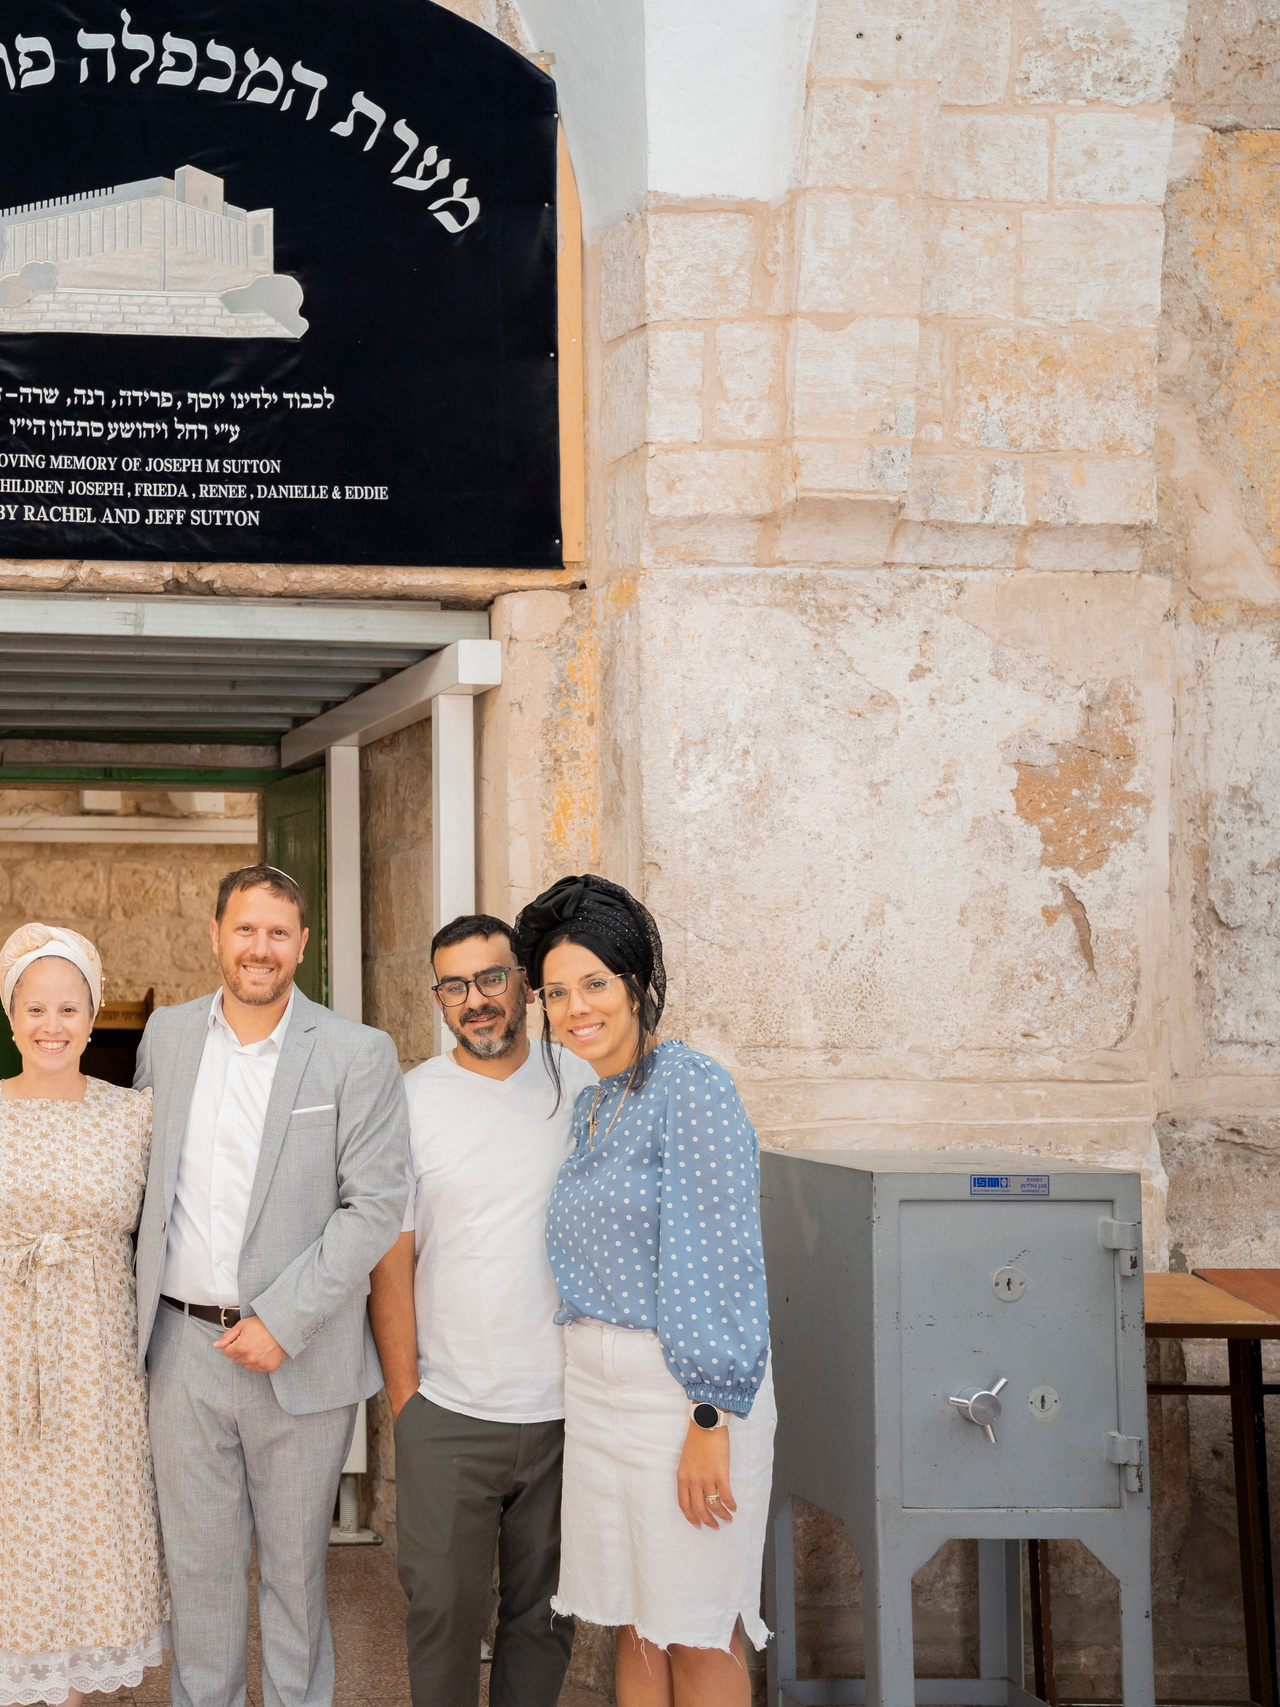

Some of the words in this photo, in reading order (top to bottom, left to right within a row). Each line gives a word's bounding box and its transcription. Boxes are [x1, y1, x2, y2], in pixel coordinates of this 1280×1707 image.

[76, 8, 327, 120] המכפלה
[329, 90, 480, 233] מערת
[66, 387, 104, 406] רנה,
[230, 386, 278, 408] ילדינו
[282, 385, 334, 408] לכבוד
[49, 419, 104, 440] סתהון
[106, 421, 167, 440] ויהושע
[173, 416, 207, 439] רחל
[49, 454, 117, 470] MEMORY
[121, 457, 141, 471] OF
[144, 457, 202, 472] JOSEPH
[205, 458, 219, 472] M
[222, 459, 281, 473] SUTTON
[256, 484, 328, 498] DANIELLE
[331, 485, 341, 499] &
[344, 485, 388, 499] EDDIE
[22, 504, 96, 523] RACHEL
[99, 507, 140, 524] AND
[144, 508, 186, 524] JEFF
[190, 509, 260, 526] SUTTON
